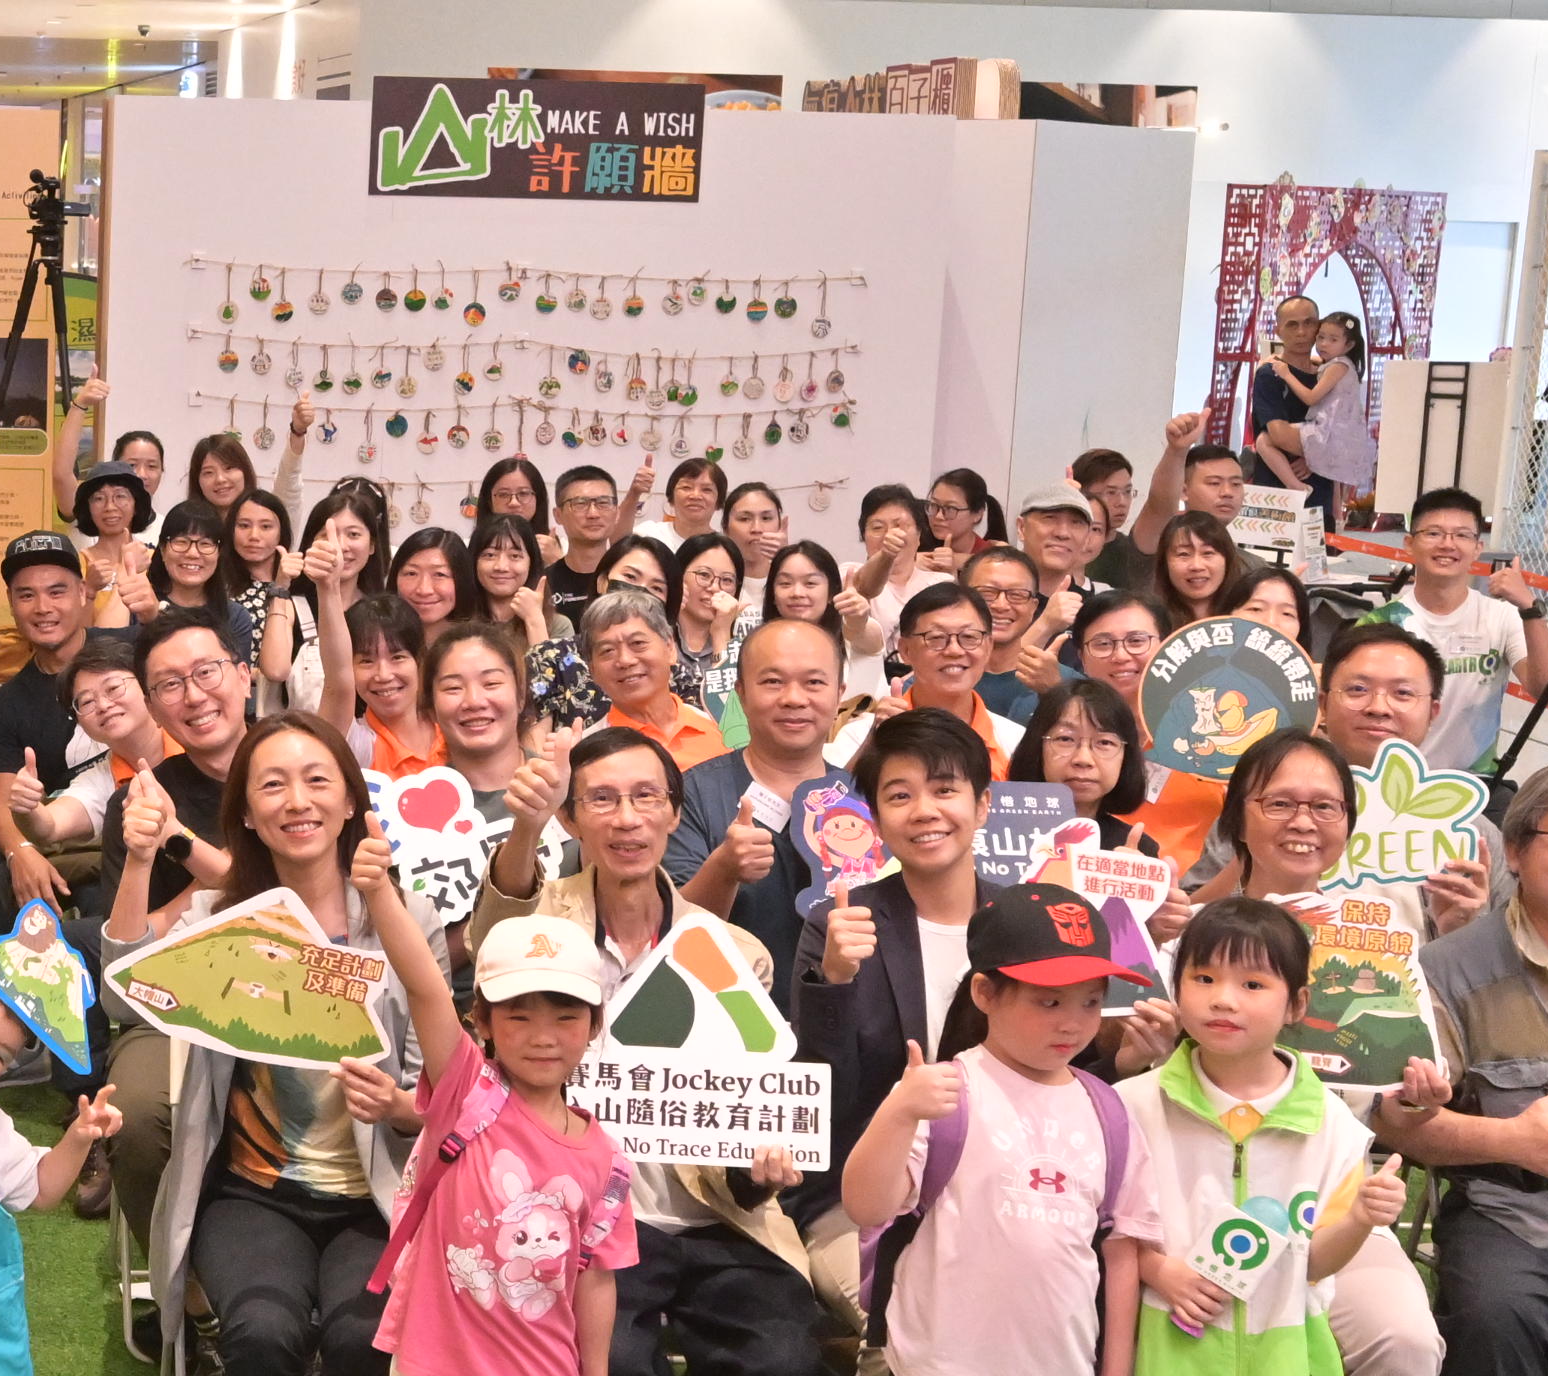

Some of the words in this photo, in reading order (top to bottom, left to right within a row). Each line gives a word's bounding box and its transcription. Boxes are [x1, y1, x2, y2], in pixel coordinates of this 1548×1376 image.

[547, 111, 600, 136] MAKE
[615, 111, 630, 136] A
[644, 112, 696, 137] WISH
[529, 143, 696, 196] 許願牆
[1151, 622, 1234, 684] 分解與否
[1244, 627, 1316, 703] 統統帶走
[1077, 854, 1166, 883] 在適當地點
[1084, 876, 1154, 902] 進行活動
[1340, 900, 1389, 925] 保持
[1313, 925, 1413, 955] 環境原貌
[300, 944, 383, 981] 充足計劃
[132, 984, 168, 1008] 大帽山
[306, 972, 368, 1002] 及準備
[565, 1063, 656, 1094] 賽馬會
[662, 1065, 752, 1100] Jockey
[759, 1071, 821, 1097] Club
[623, 1136, 651, 1157] No
[657, 1138, 712, 1160] Trace
[717, 1140, 821, 1165] Eduion
